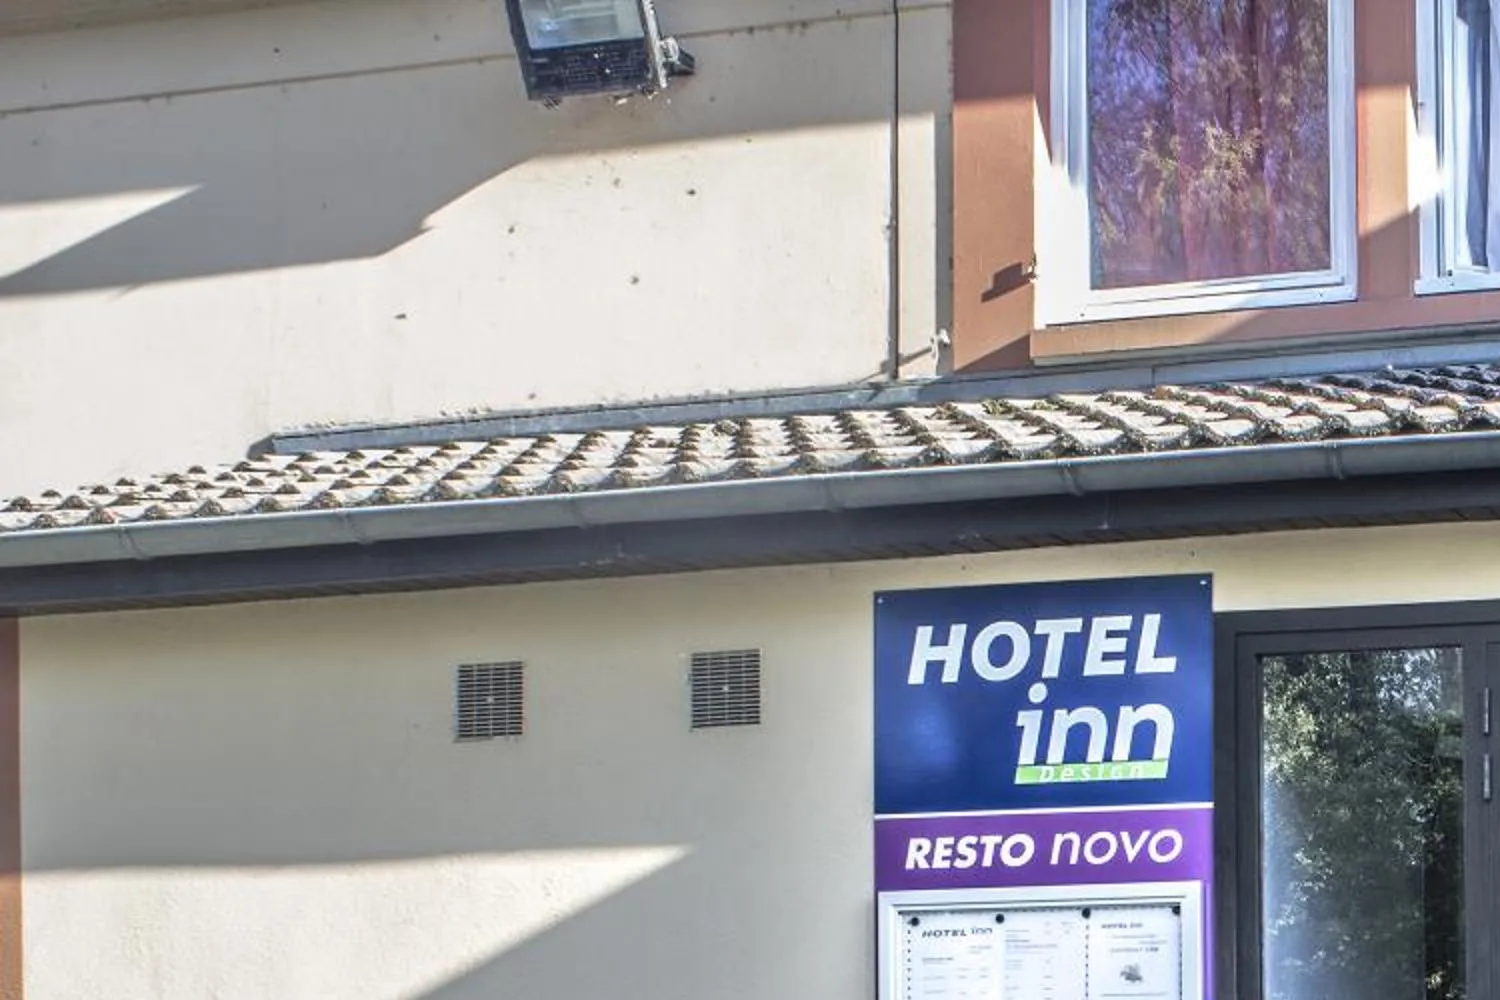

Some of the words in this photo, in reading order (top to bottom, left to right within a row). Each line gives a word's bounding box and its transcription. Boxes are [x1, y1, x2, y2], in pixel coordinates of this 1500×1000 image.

[908, 613, 1177, 685] HOTEL
[1015, 682, 1175, 766] inn
[905, 833, 1035, 869] RESTO
